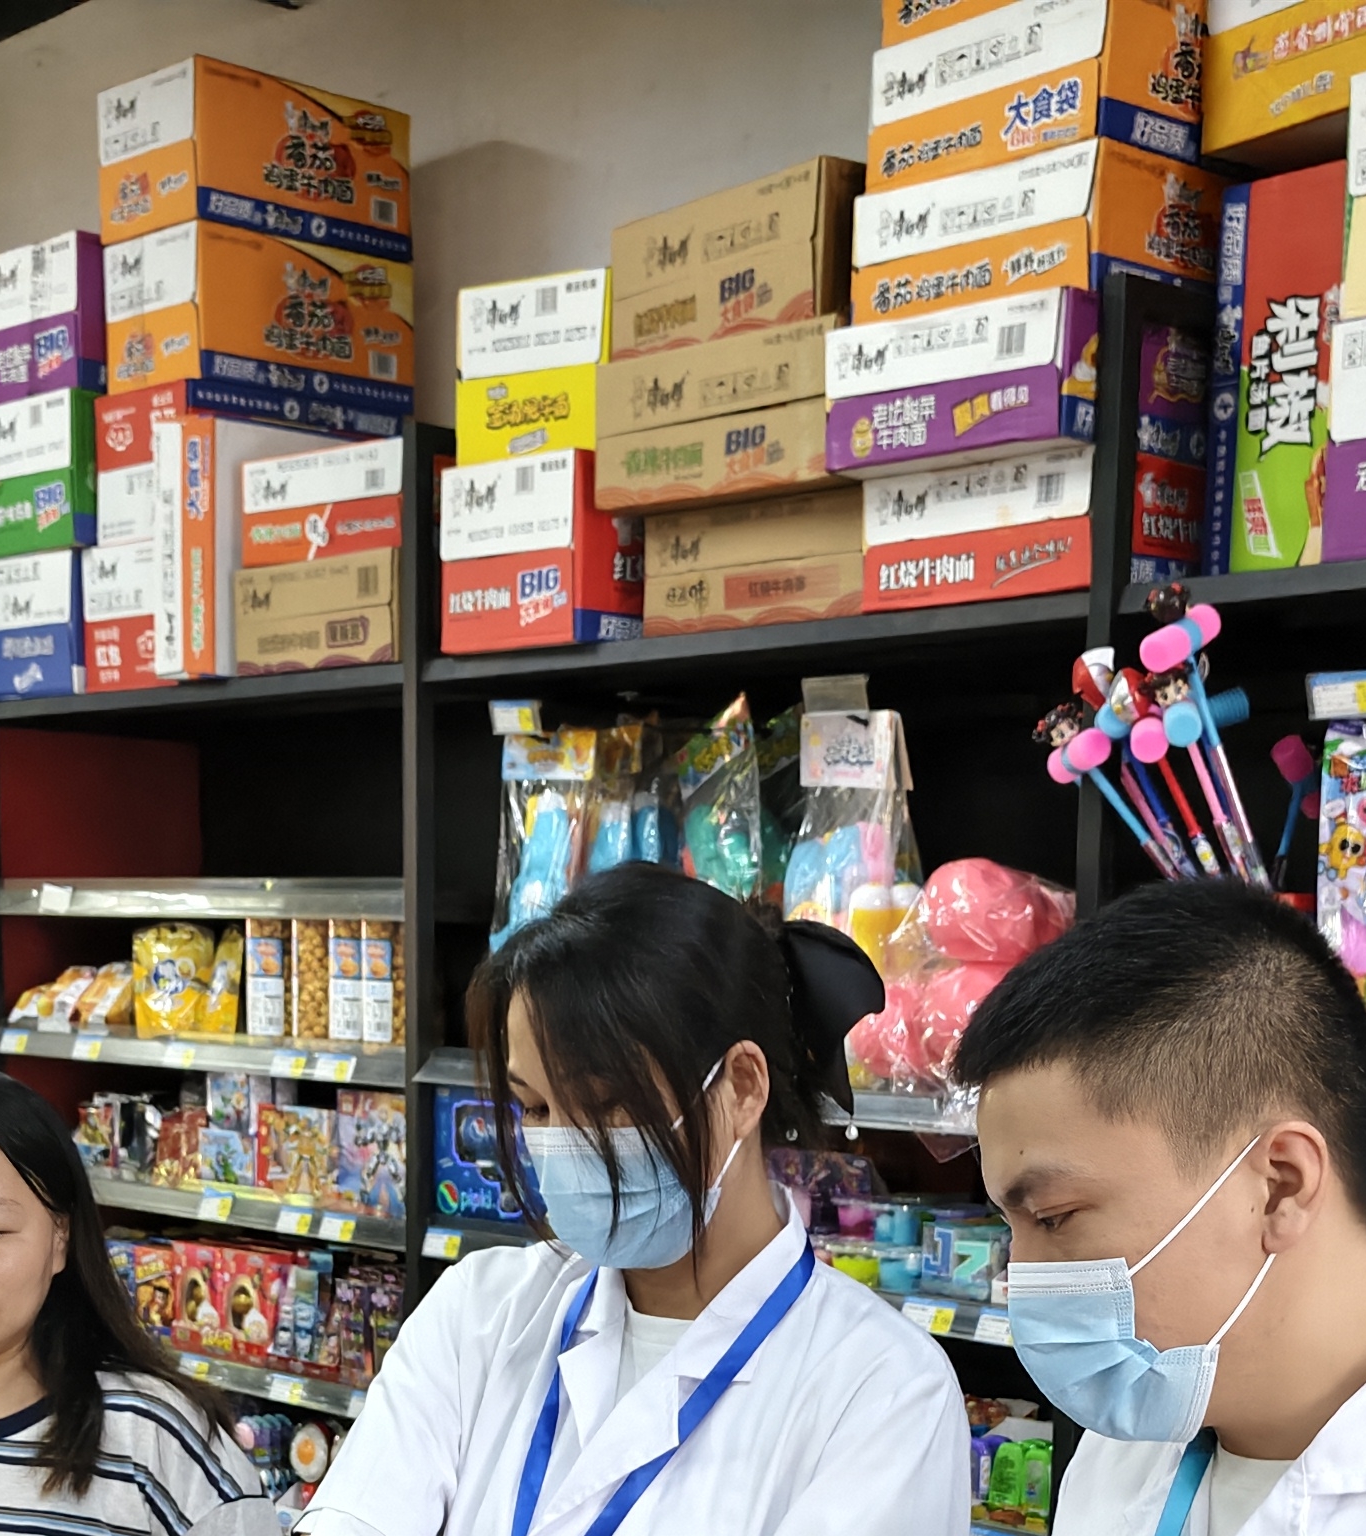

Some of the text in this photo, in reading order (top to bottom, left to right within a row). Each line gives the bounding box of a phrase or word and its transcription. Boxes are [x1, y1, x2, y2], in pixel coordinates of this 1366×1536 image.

[1003, 77, 1083, 139] 大食袋
[285, 134, 335, 172] 番茄
[720, 268, 755, 305] BIG
[285, 293, 335, 330] 番茄
[1259, 295, 1322, 462] 剁椒
[724, 423, 767, 457] BIG
[518, 567, 562, 601] BIG
[878, 552, 975, 592] 红烧牛肉面
